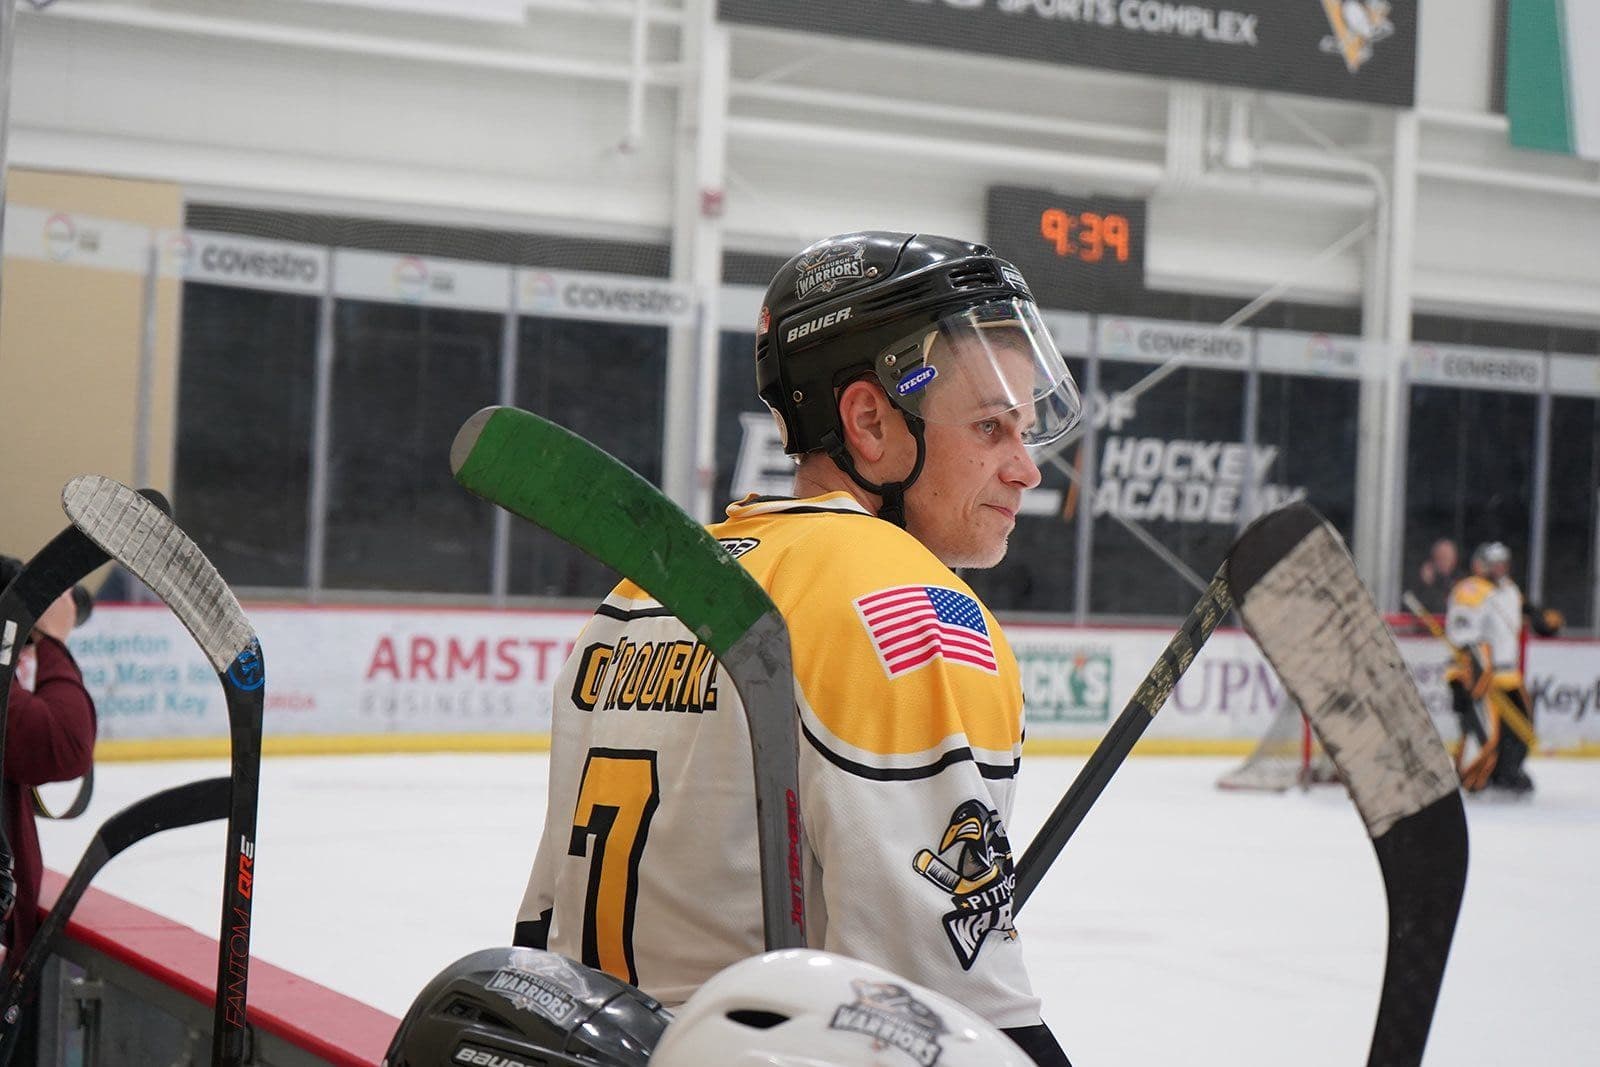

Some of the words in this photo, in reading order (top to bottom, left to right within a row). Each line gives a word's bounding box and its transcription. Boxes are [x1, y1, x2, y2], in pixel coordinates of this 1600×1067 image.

[1119, 5, 1259, 46] COMPLEX
[1041, 207, 1129, 264] 9:39
[202, 244, 319, 284] covestro
[798, 260, 860, 296] WARRIORS
[899, 369, 932, 392] ITECH
[1102, 436, 1279, 482] HOCKEY
[568, 747, 660, 990] 7
[225, 907, 250, 1029] FANTOM
[492, 971, 571, 1019] WARRIORS
[832, 1006, 938, 1066] WARRIORS
